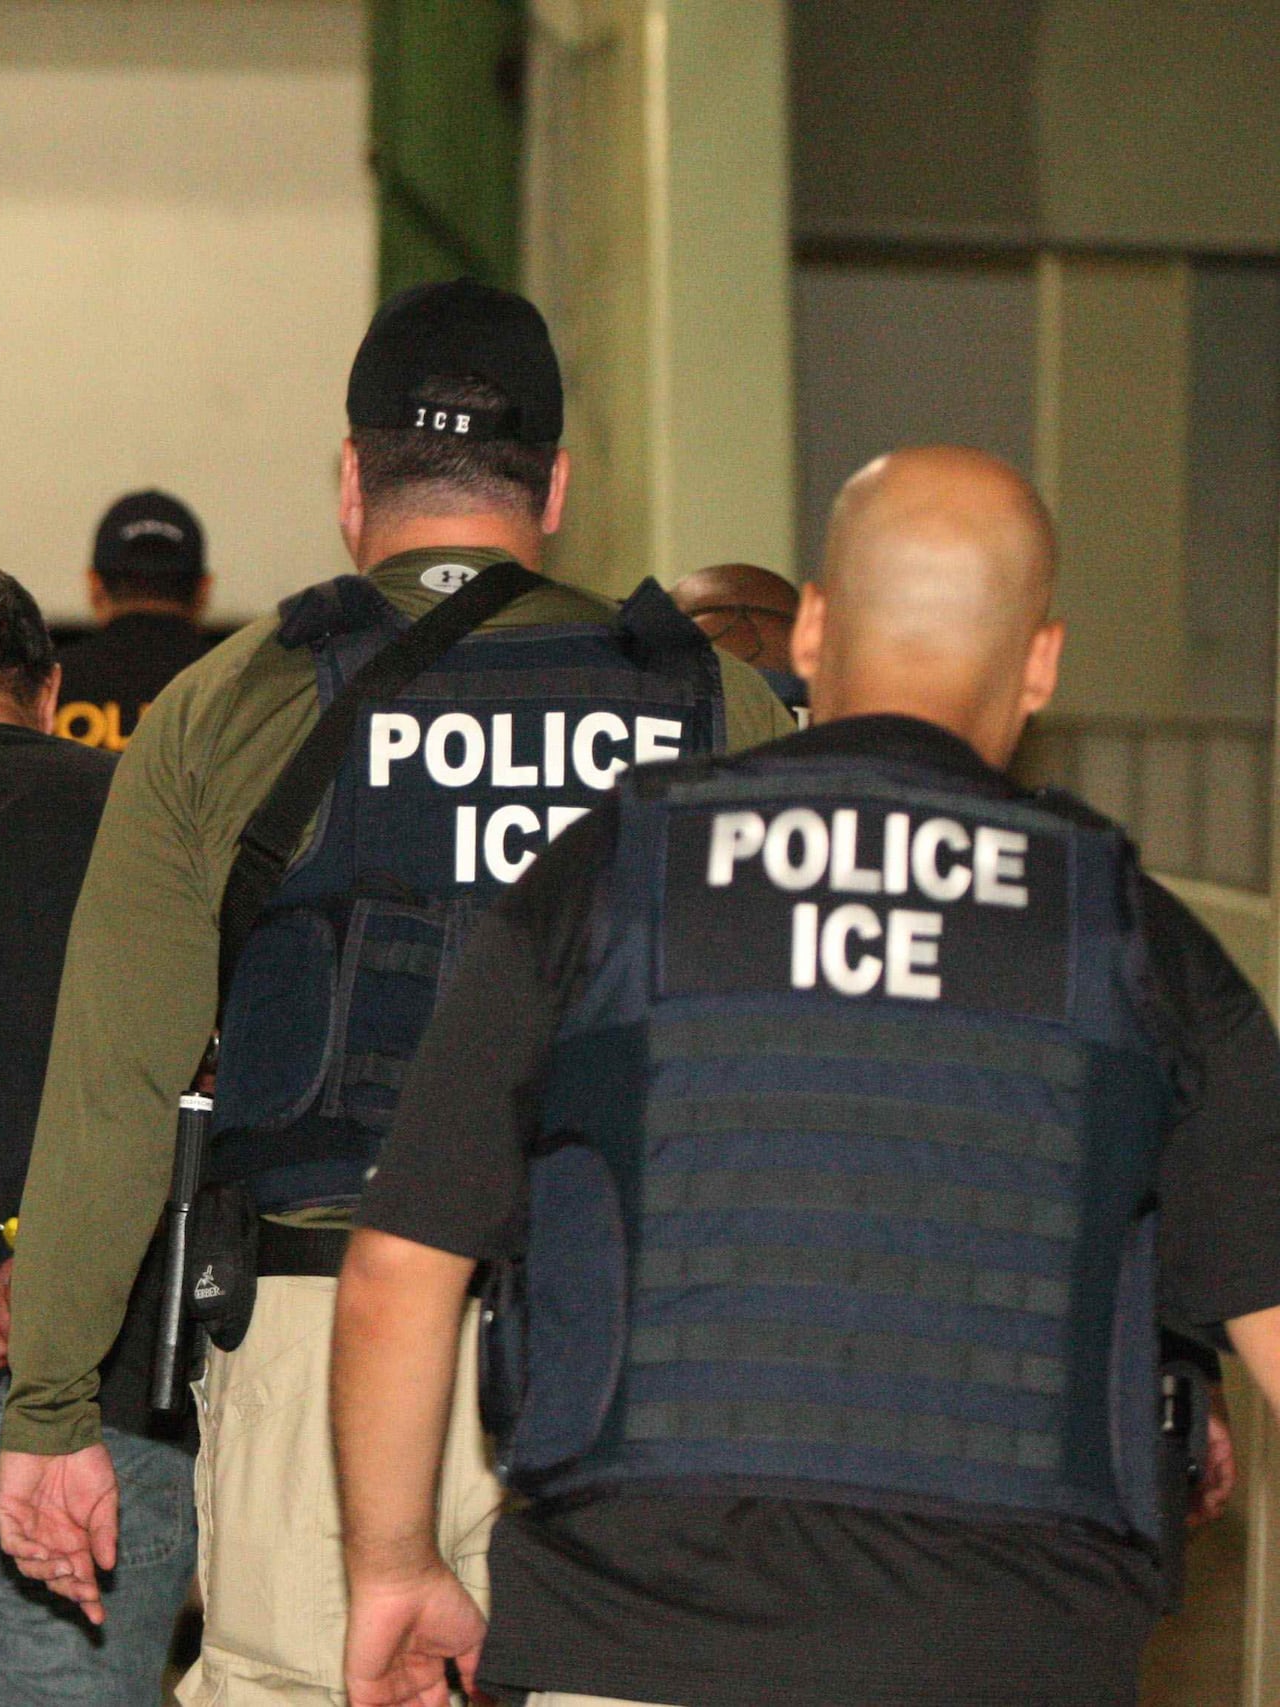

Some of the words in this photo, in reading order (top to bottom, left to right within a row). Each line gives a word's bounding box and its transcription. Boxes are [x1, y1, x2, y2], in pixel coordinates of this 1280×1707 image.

[415, 408, 471, 433] ICE
[370, 711, 682, 790] POLICE
[455, 804, 592, 884] IC
[707, 807, 1028, 908] POLICE
[791, 902, 943, 1000] ICE
